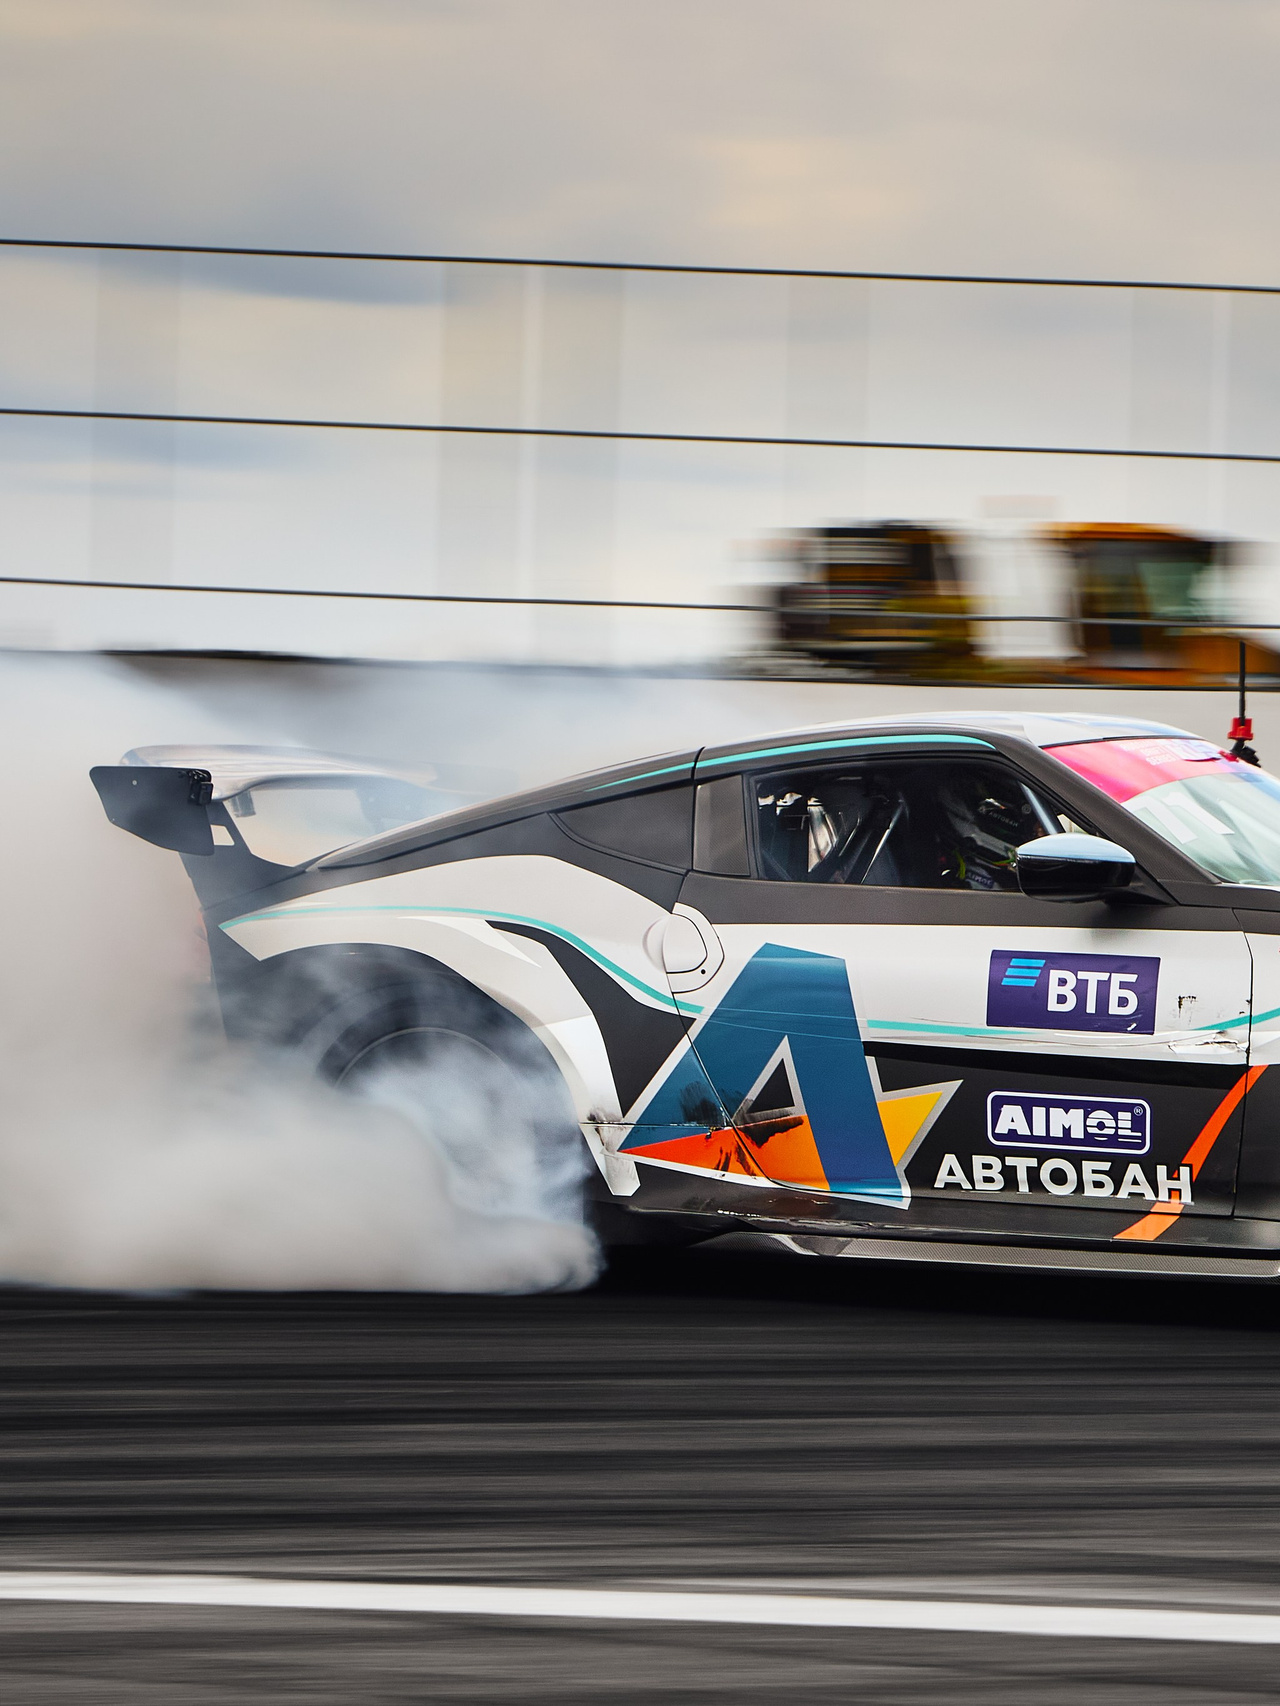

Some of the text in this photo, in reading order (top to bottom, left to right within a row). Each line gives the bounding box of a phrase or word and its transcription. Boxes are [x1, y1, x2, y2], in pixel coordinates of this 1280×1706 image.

[1047, 969, 1139, 1016] ВТБ
[994, 1104, 1142, 1143] AIMOL
[933, 1153, 1194, 1204] АВТОБАН
